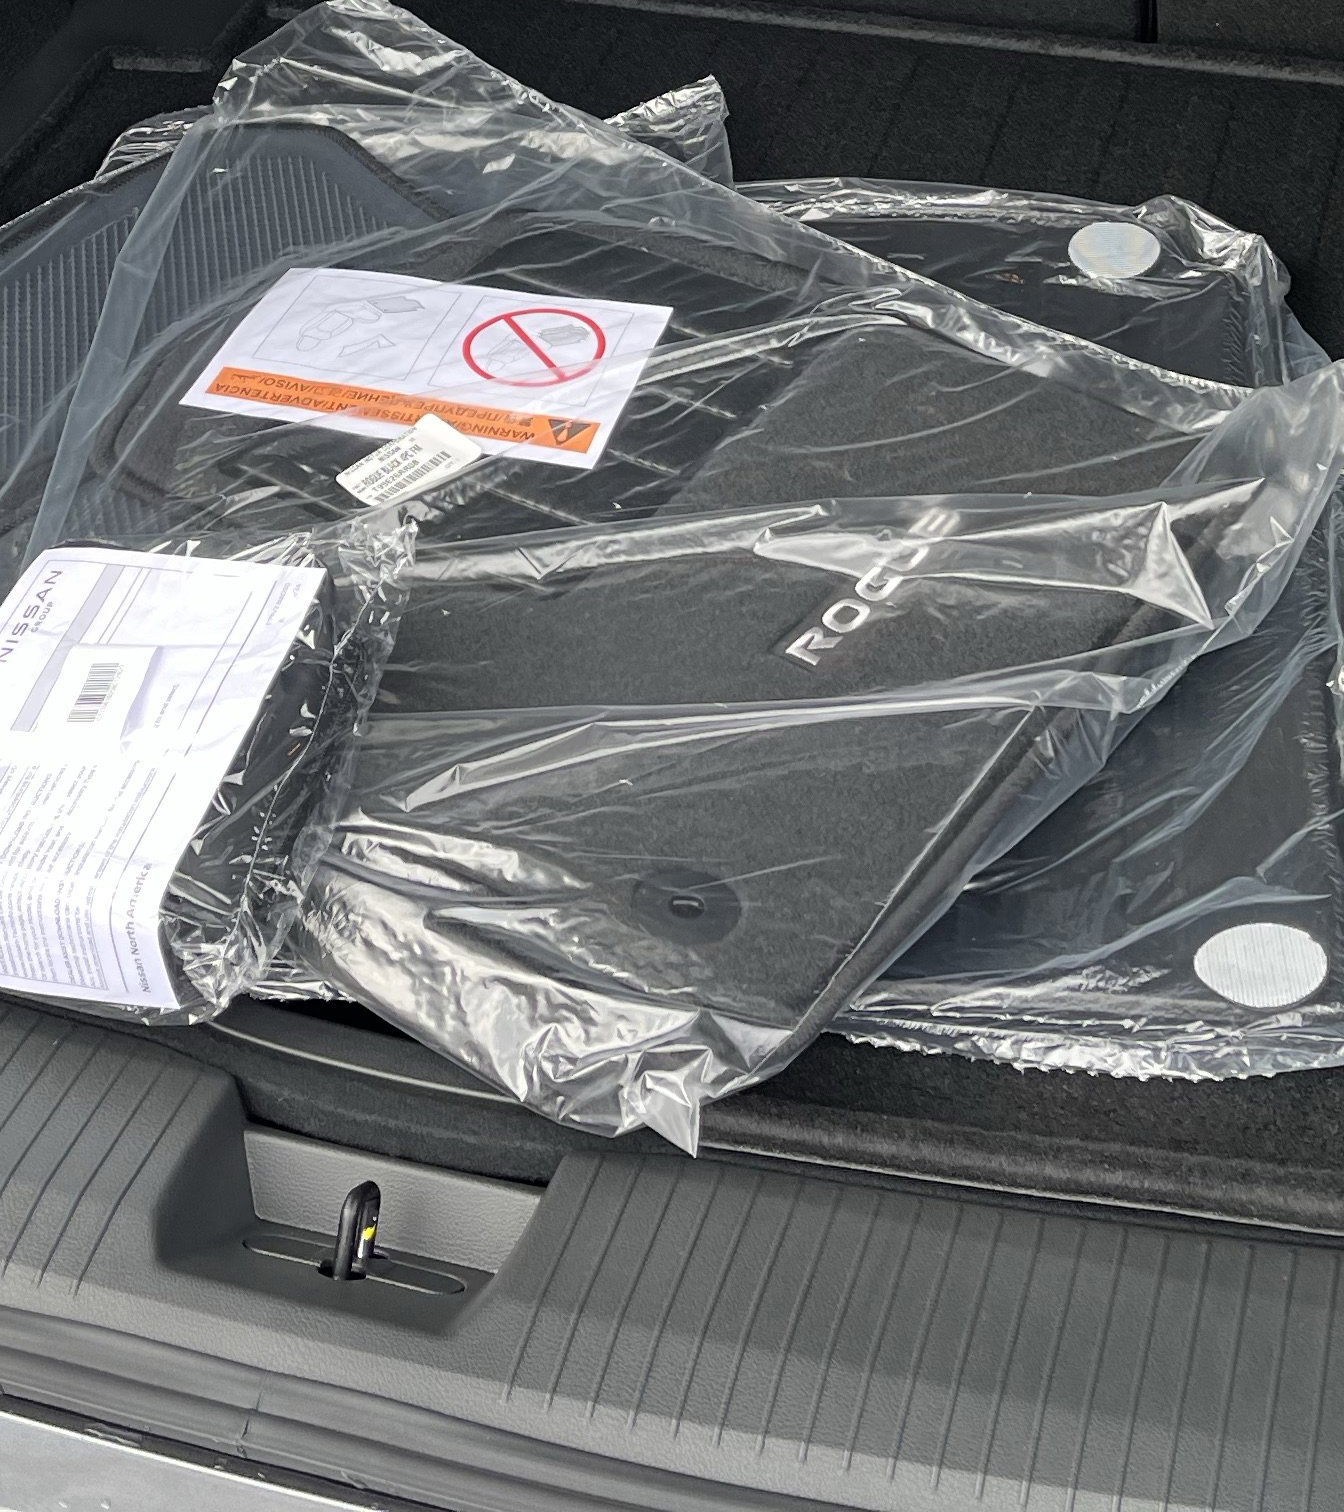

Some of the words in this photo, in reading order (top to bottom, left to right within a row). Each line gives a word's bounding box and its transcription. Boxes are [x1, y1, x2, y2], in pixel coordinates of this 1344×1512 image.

[785, 507, 960, 666] ROGUE
[30, 601, 54, 633] GROUP
[125, 921, 140, 955] North
[138, 957, 152, 993] Nissan
